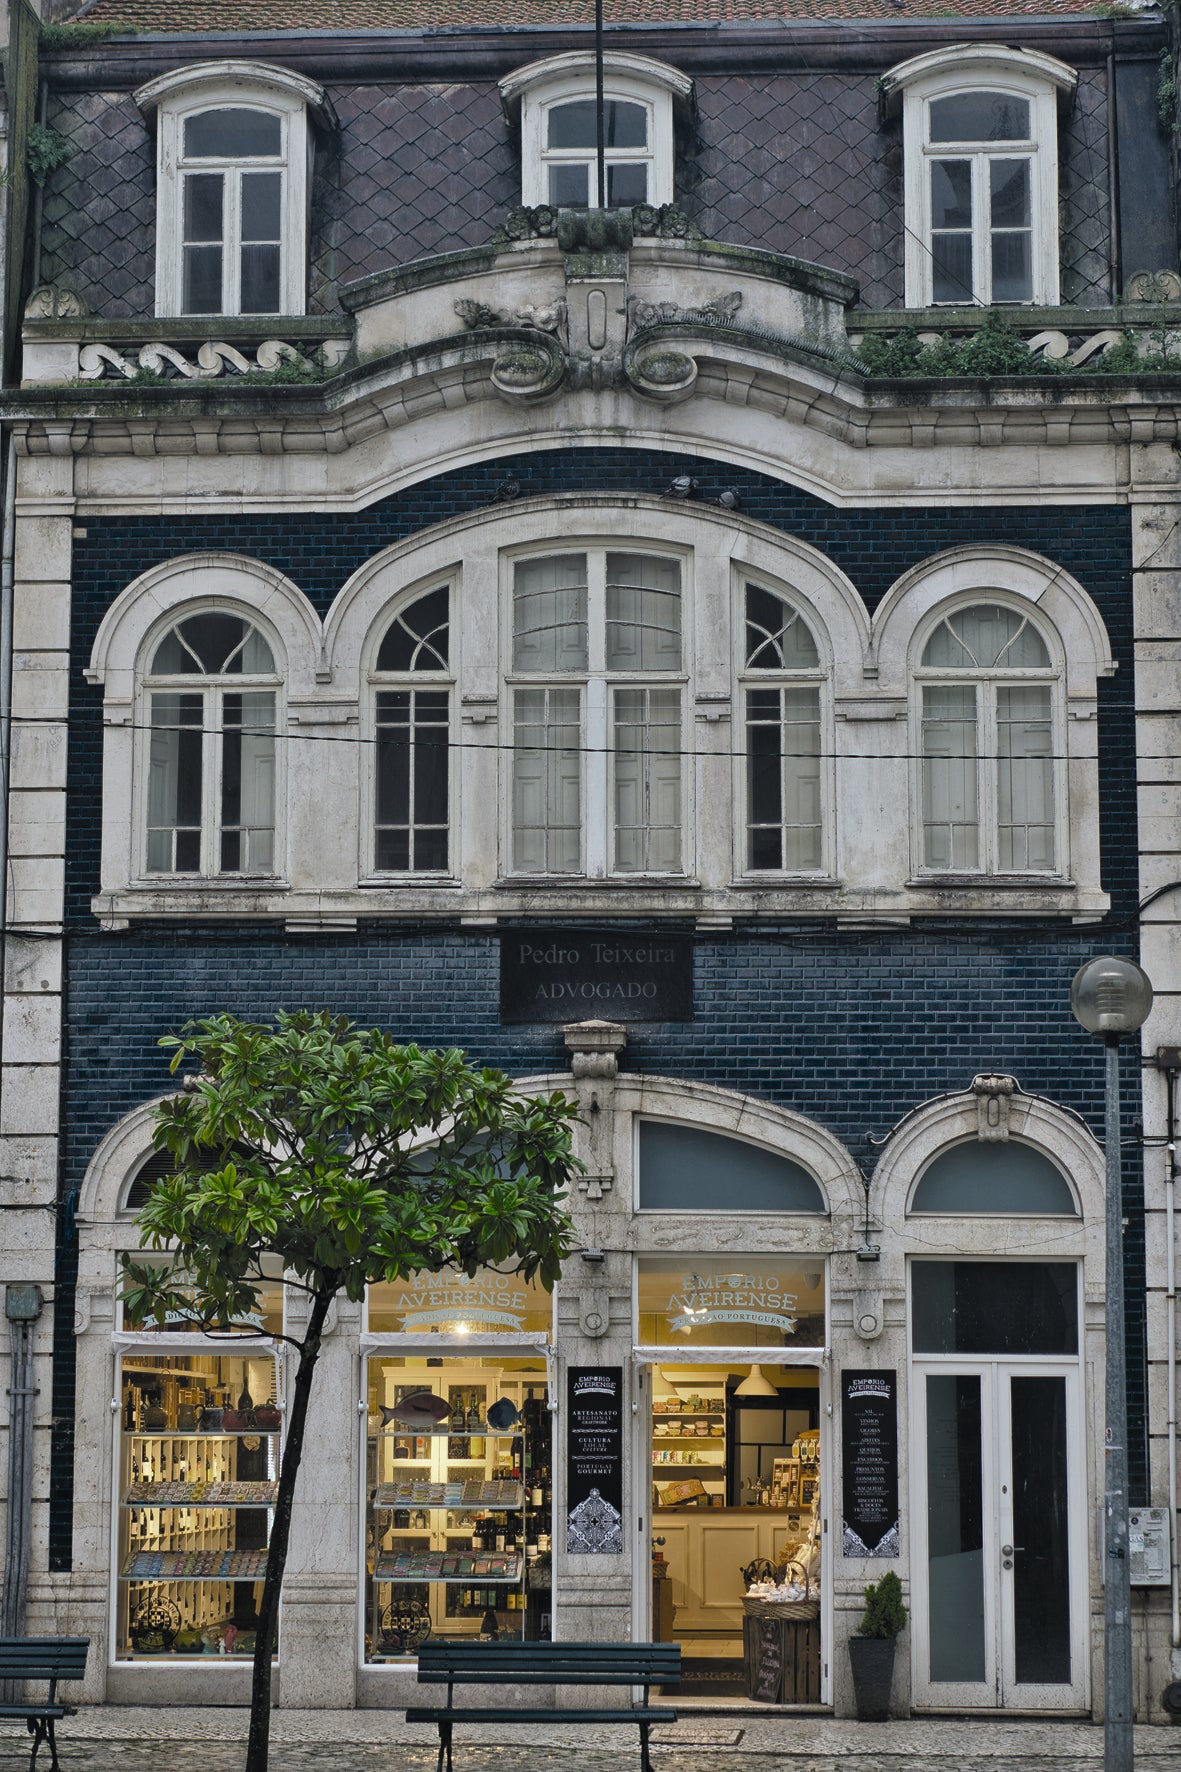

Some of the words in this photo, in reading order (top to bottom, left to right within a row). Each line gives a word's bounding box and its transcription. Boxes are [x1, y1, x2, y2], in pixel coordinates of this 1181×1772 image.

[519, 944, 580, 964] Pedro
[590, 943, 676, 964] Teixeira
[535, 982, 657, 999] ADVOGADO
[395, 1290, 528, 1310] AVEIRENSE
[666, 1291, 798, 1311] AVEIRENSE
[727, 1313, 787, 1325] PORTUGUESA
